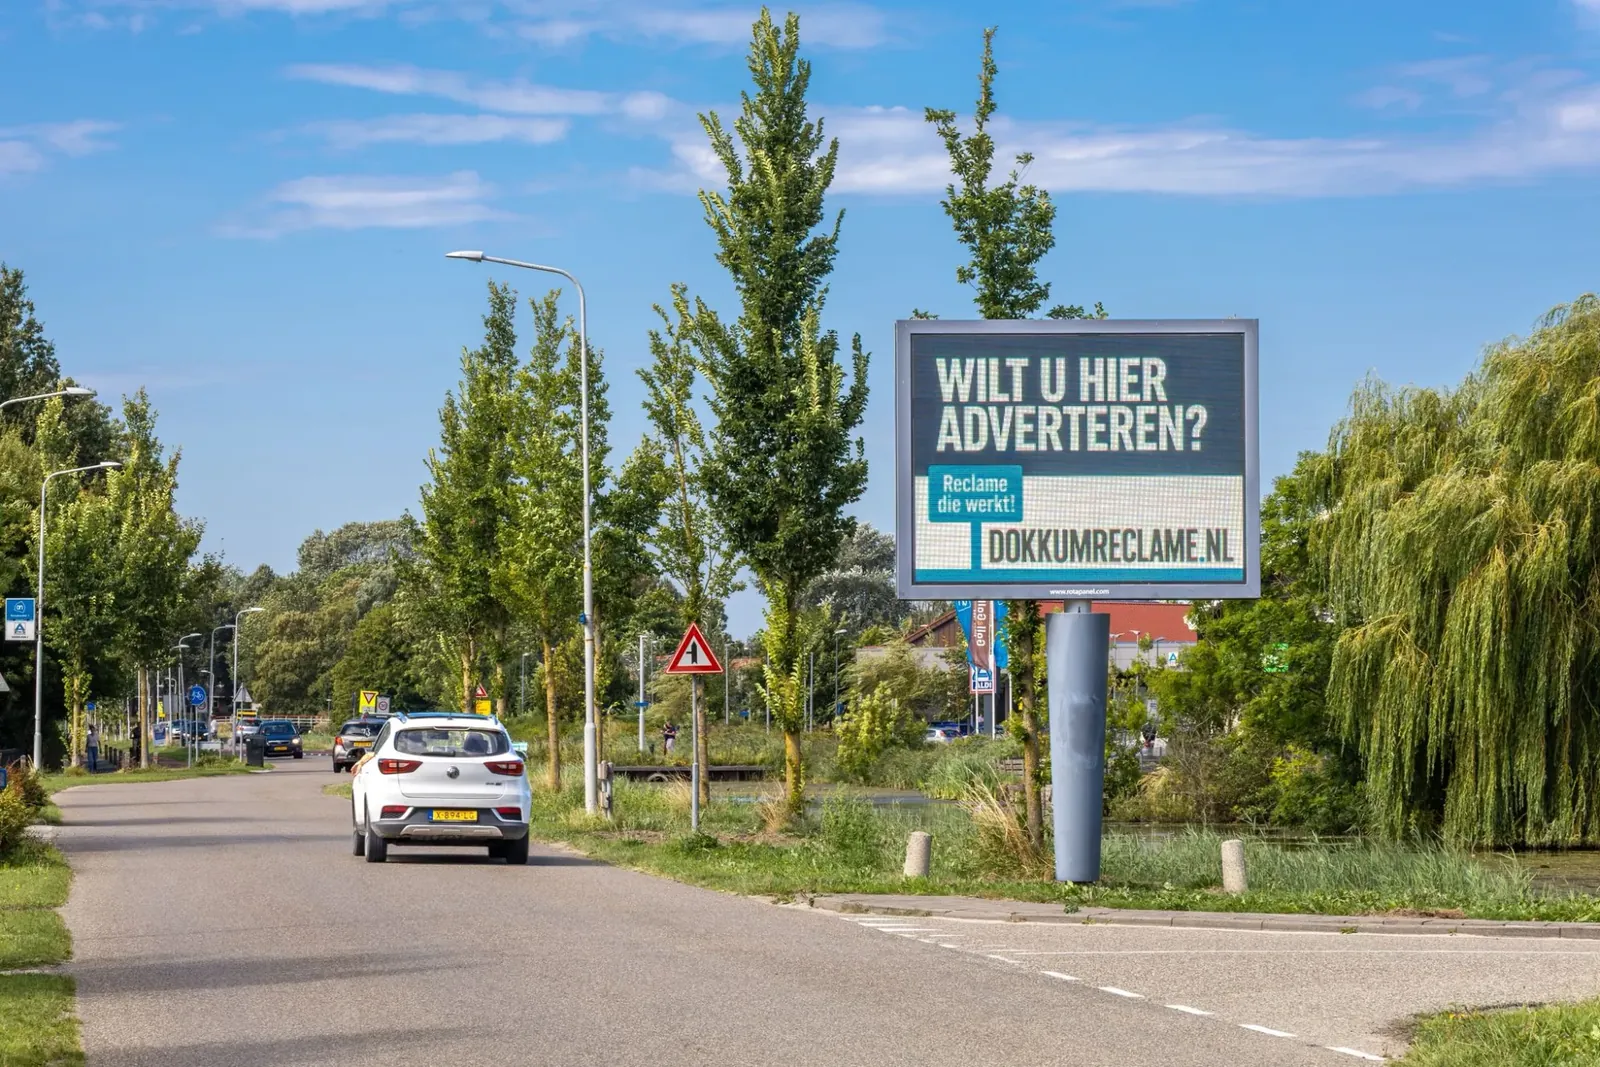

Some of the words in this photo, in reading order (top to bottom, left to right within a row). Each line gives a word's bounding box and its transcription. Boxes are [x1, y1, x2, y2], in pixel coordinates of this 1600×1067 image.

[936, 357, 1029, 402] WILT
[1040, 357, 1066, 402] U
[1079, 357, 1167, 402] HIER
[936, 404, 1208, 451] ADVERTEREN?
[942, 474, 1008, 492] Reclame
[938, 497, 961, 513] die
[965, 496, 1016, 513] werkt!
[988, 528, 1234, 563] DOKKUMRECLAME.NL
[1050, 588, 1110, 596] www.rotapanel.com
